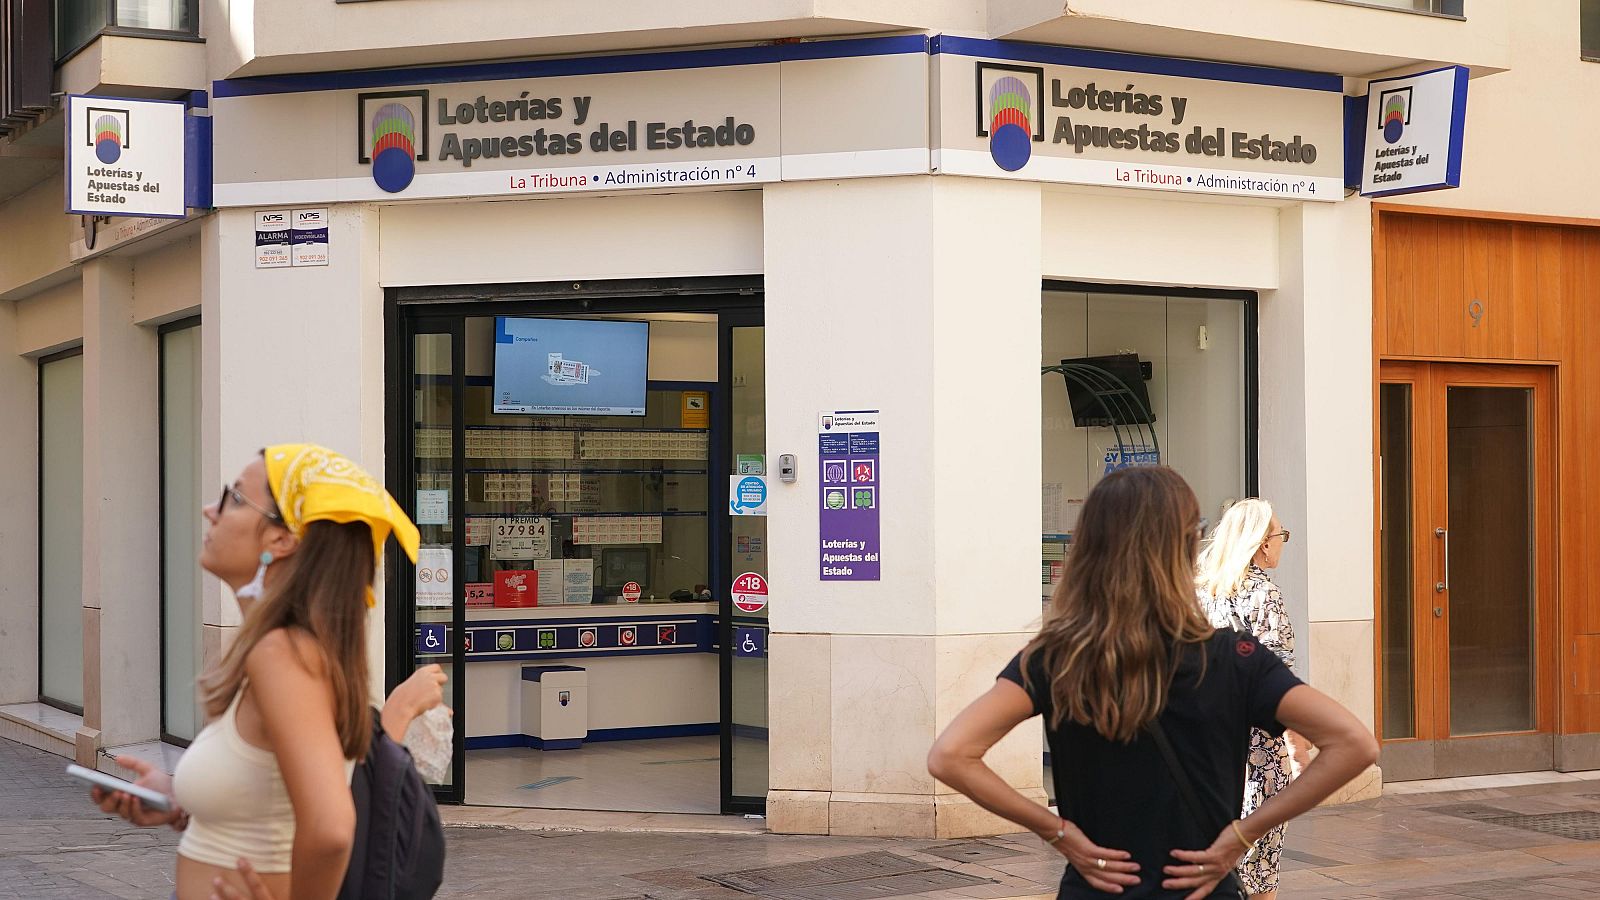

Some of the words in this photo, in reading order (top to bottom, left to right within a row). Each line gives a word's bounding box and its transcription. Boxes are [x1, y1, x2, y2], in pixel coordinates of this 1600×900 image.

[438, 91, 563, 126] Loterías
[573, 95, 592, 125] y
[1051, 78, 1163, 117] Loterías
[1170, 95, 1187, 125] y
[438, 127, 583, 167] Apuestas
[589, 120, 637, 152] del
[646, 116, 756, 149] Estado
[1052, 116, 1182, 154] Apuestas
[1184, 126, 1226, 158] del
[1231, 132, 1317, 165] Estado
[1374, 147, 1408, 159] Loterías
[1410, 146, 1417, 157] y
[1374, 157, 1414, 171] Apuestas
[1415, 154, 1429, 166] del
[87, 166, 134, 180] Loterías
[135, 170, 143, 181] y
[510, 175, 527, 190] La
[530, 171, 588, 188] Tribuna
[604, 167, 721, 186] Administración
[746, 164, 757, 179] 4
[1373, 170, 1402, 184] Estado
[87, 180, 141, 194] Apuestas
[142, 182, 160, 194] del
[1115, 168, 1130, 182] La
[1133, 169, 1183, 186] Tribuna
[1196, 174, 1290, 195] Administración
[1308, 182, 1316, 195] 4
[87, 193, 126, 205] Estado
[263, 214, 283, 222] NPS
[300, 212, 319, 220] NPS
[258, 232, 288, 240] ALARMA
[1468, 299, 1484, 328] 9
[510, 517, 540, 525] PREMIO
[498, 525, 545, 536] 37984
[822, 539, 858, 550] Loterías
[859, 541, 866, 551] y
[822, 553, 863, 564] Apuestas
[864, 552, 879, 562] del
[822, 566, 853, 577] Estado
[739, 576, 761, 591] +18
